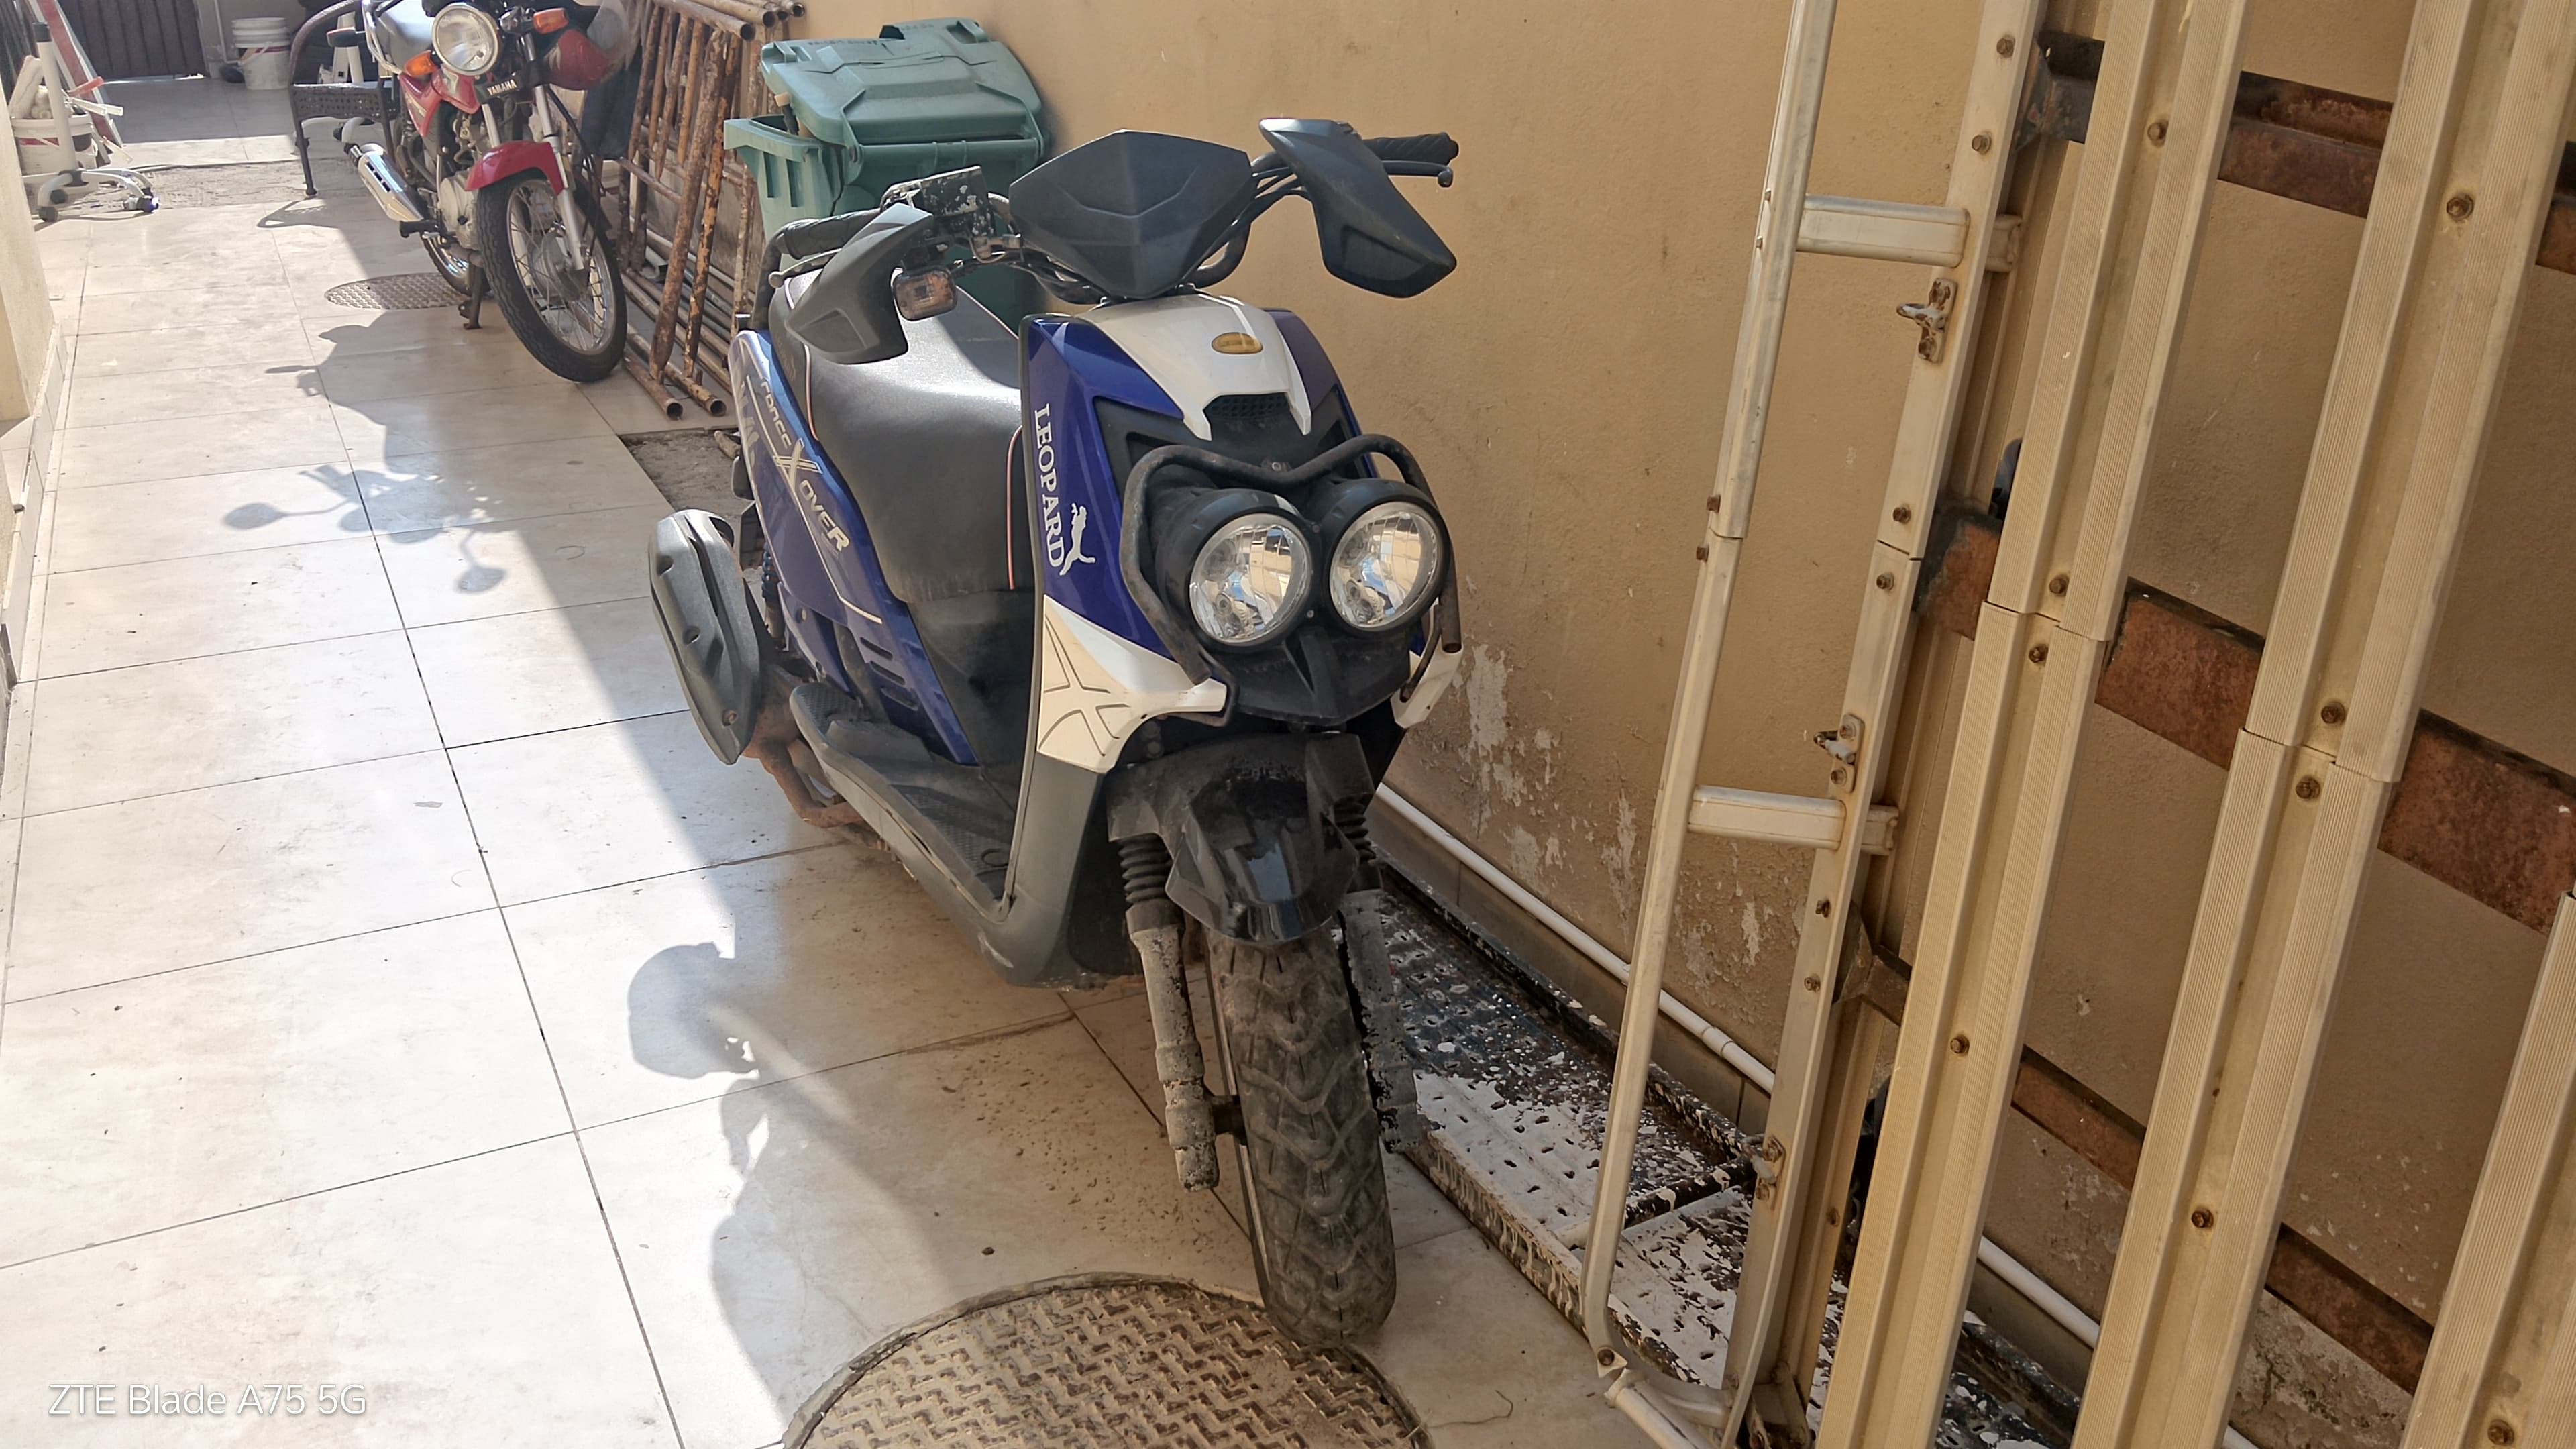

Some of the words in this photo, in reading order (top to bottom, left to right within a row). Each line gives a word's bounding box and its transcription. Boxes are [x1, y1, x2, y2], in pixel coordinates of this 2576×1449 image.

[486, 79, 517, 95] YAMAHA
[798, 479, 850, 551] OVER
[1034, 403, 1065, 568] LEOPARD
